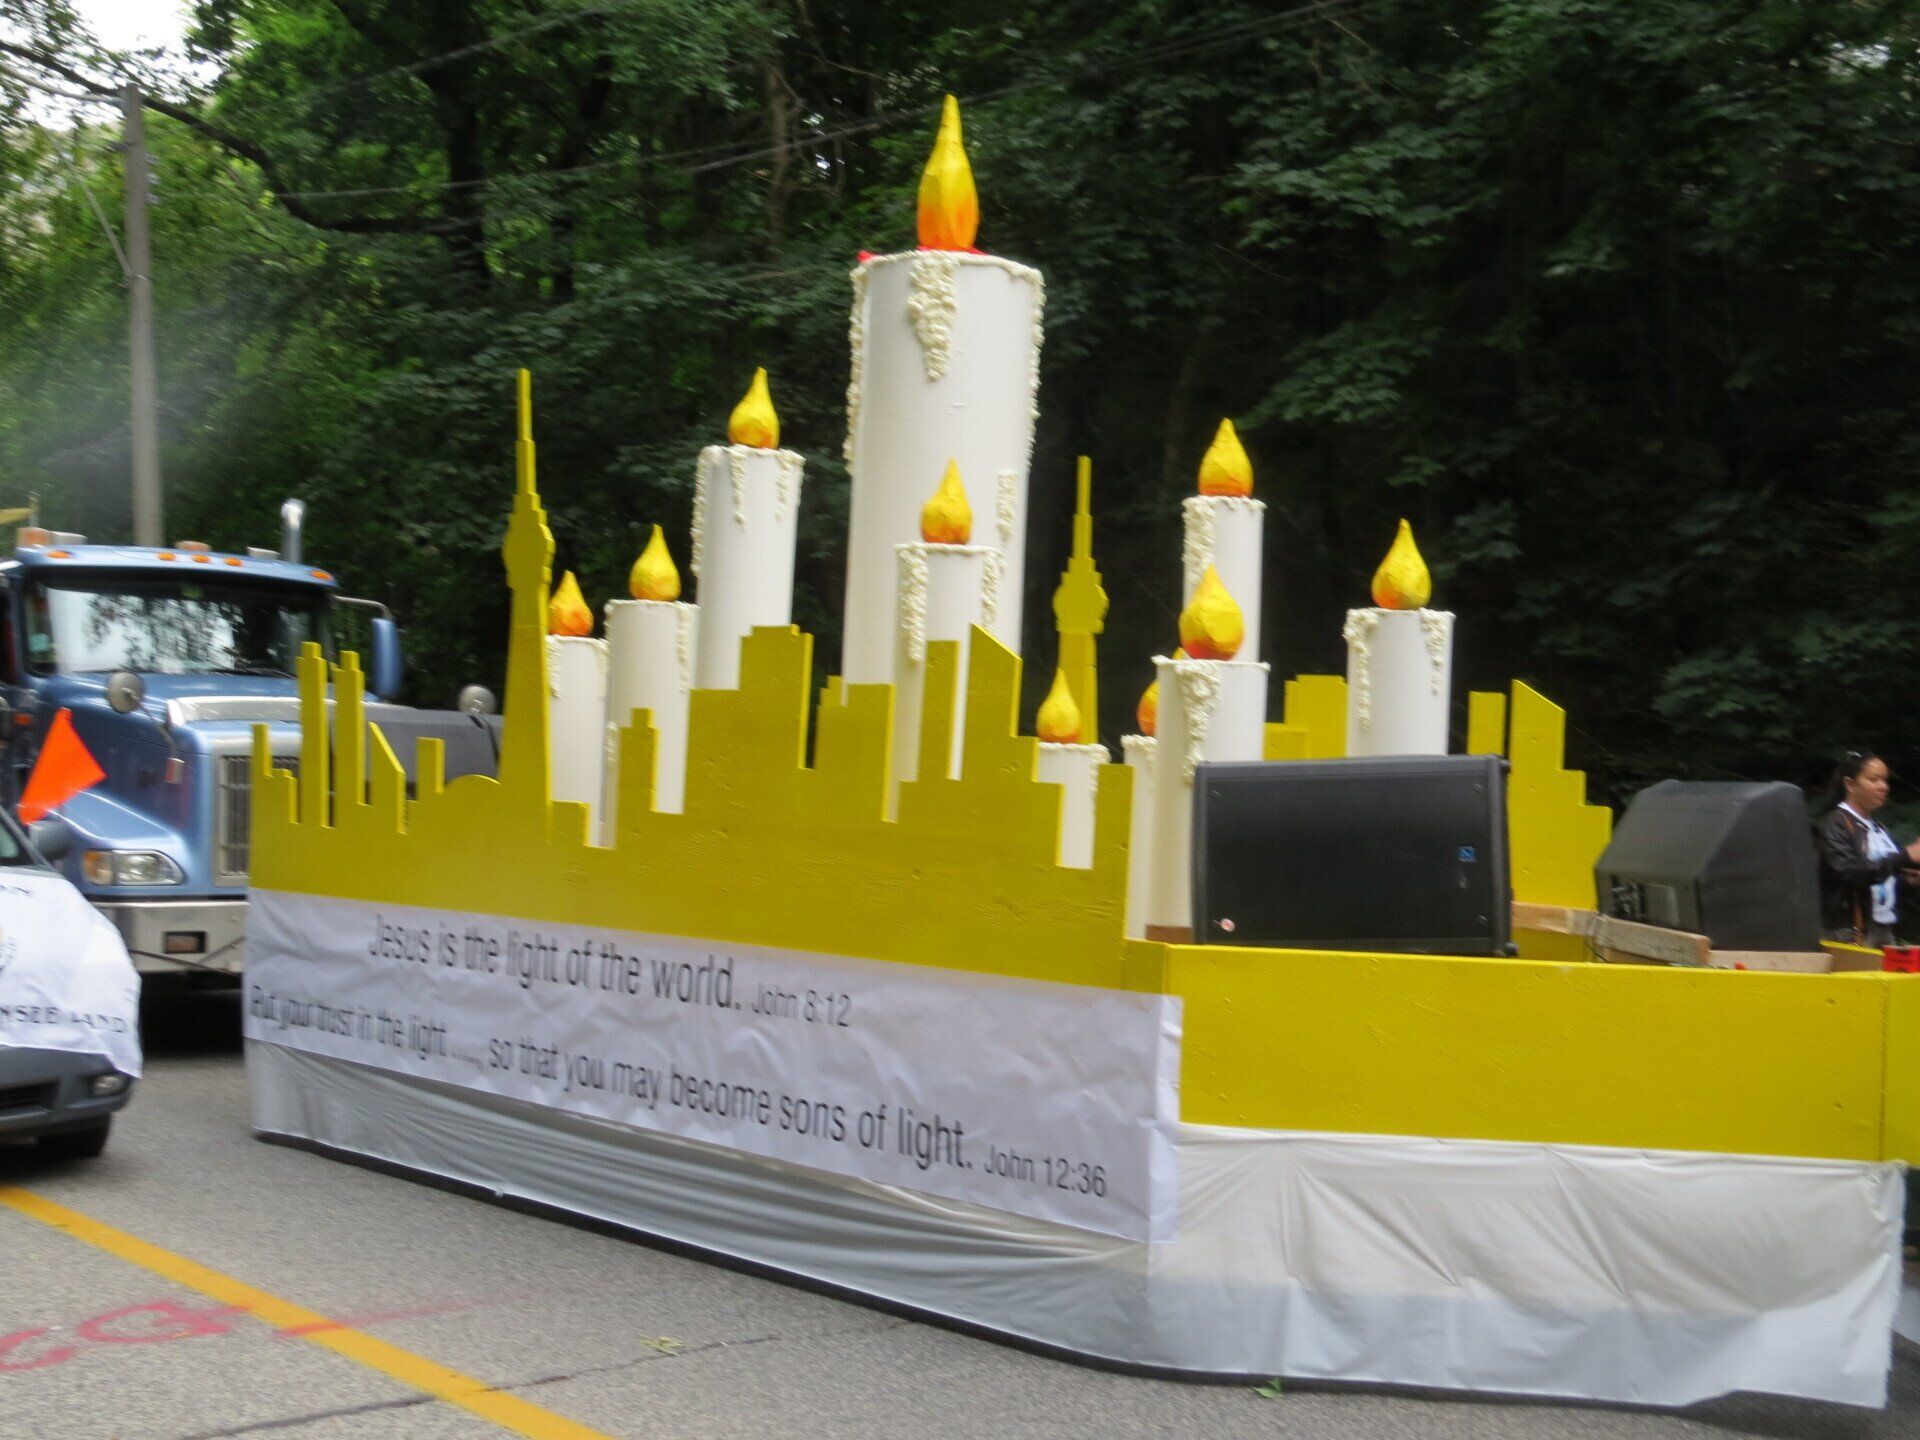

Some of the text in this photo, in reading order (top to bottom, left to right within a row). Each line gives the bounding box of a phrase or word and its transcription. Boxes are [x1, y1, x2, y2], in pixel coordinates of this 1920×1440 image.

[367, 914, 852, 1028] Jesus is the light of the world. John 8:12
[489, 1037, 514, 1071] so
[519, 1036, 560, 1081] that
[562, 1052, 605, 1093] you
[612, 1061, 663, 1110] may
[670, 1063, 773, 1126] become
[779, 1094, 847, 1142] sons
[858, 1103, 888, 1151] of
[898, 1106, 974, 1171] light.
[983, 1144, 1036, 1184] John
[1043, 1154, 1109, 1199] 12:36
